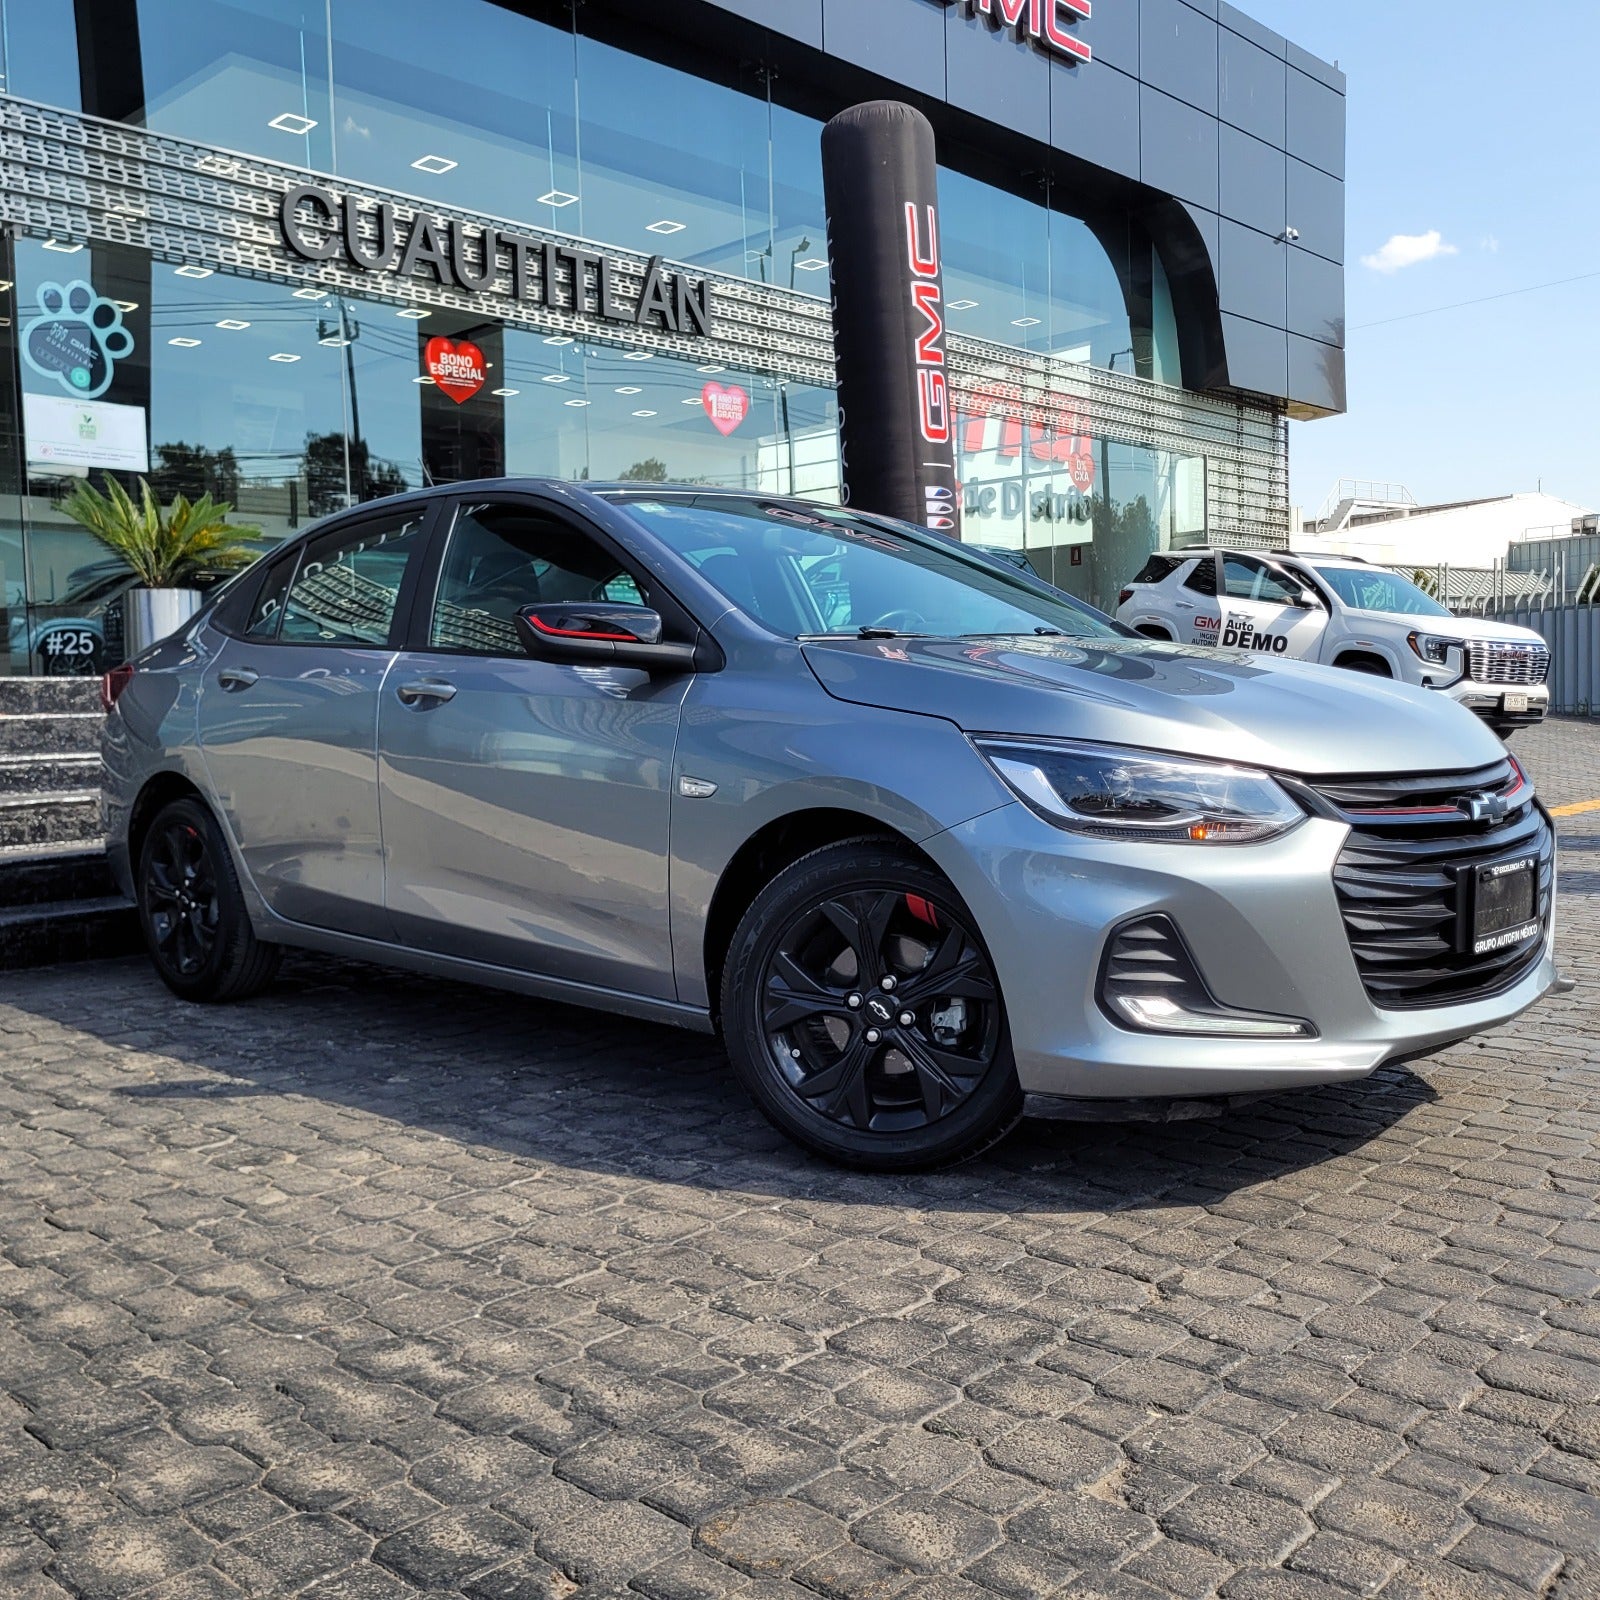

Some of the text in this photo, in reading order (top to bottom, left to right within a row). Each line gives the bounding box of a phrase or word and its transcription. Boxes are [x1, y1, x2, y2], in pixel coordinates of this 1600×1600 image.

[279, 185, 713, 338] CUAUTITLÁN
[903, 201, 950, 444] GMC
[439, 352, 473, 368] BONO
[430, 362, 485, 381] ESPECIAL
[708, 393, 718, 417] 1
[717, 403, 743, 412] SEGURO
[717, 410, 743, 421] GRATIS
[1076, 459, 1087, 471] 0%
[1074, 470, 1089, 482] CXA
[1226, 619, 1254, 632] Auto
[46, 631, 94, 656] #25
[1222, 629, 1288, 653] DEMO
[1474, 923, 1538, 953] GRUPO AUTOFIN MÉXICO
